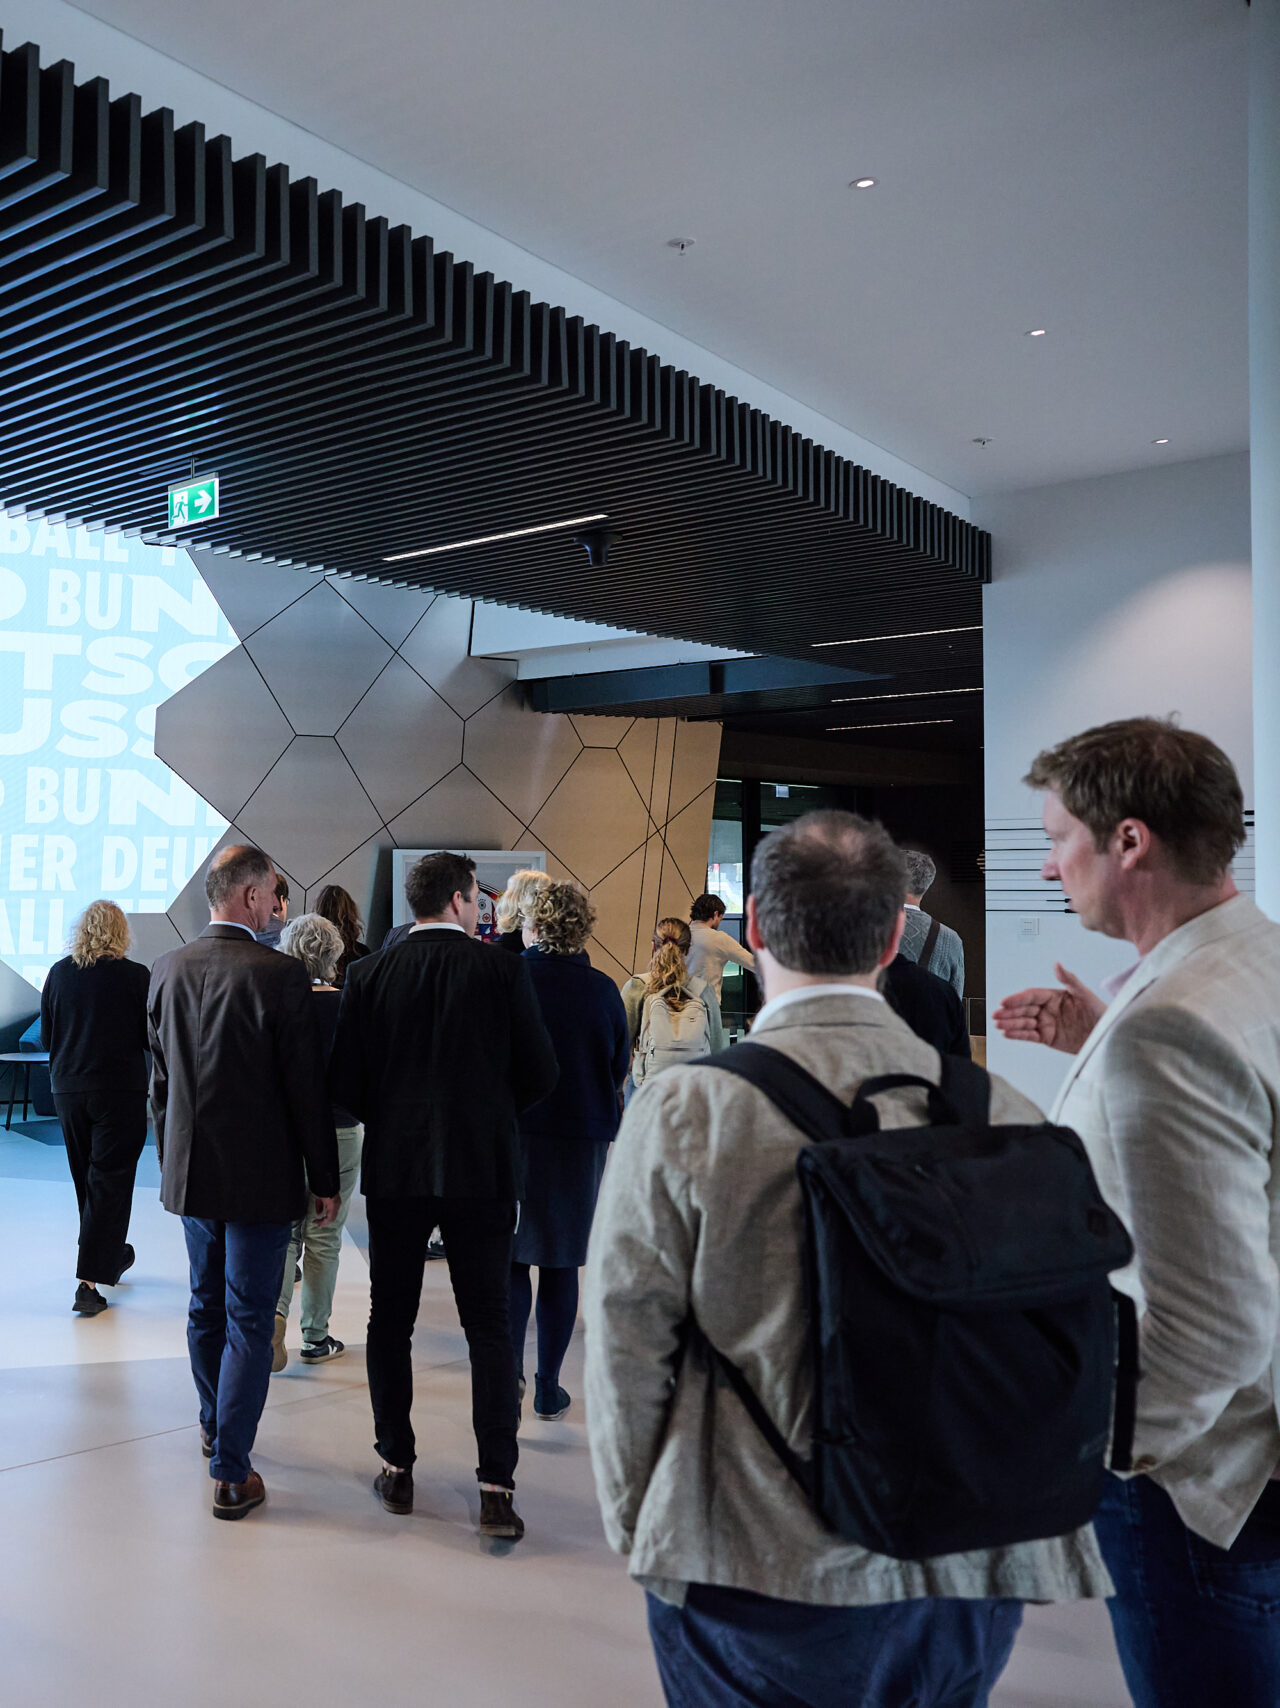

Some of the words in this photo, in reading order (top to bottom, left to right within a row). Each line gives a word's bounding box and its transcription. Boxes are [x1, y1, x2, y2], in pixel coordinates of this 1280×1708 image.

[46, 568, 241, 638] BUN
[25, 766, 231, 827] BUN
[101, 835, 218, 892] DEU
